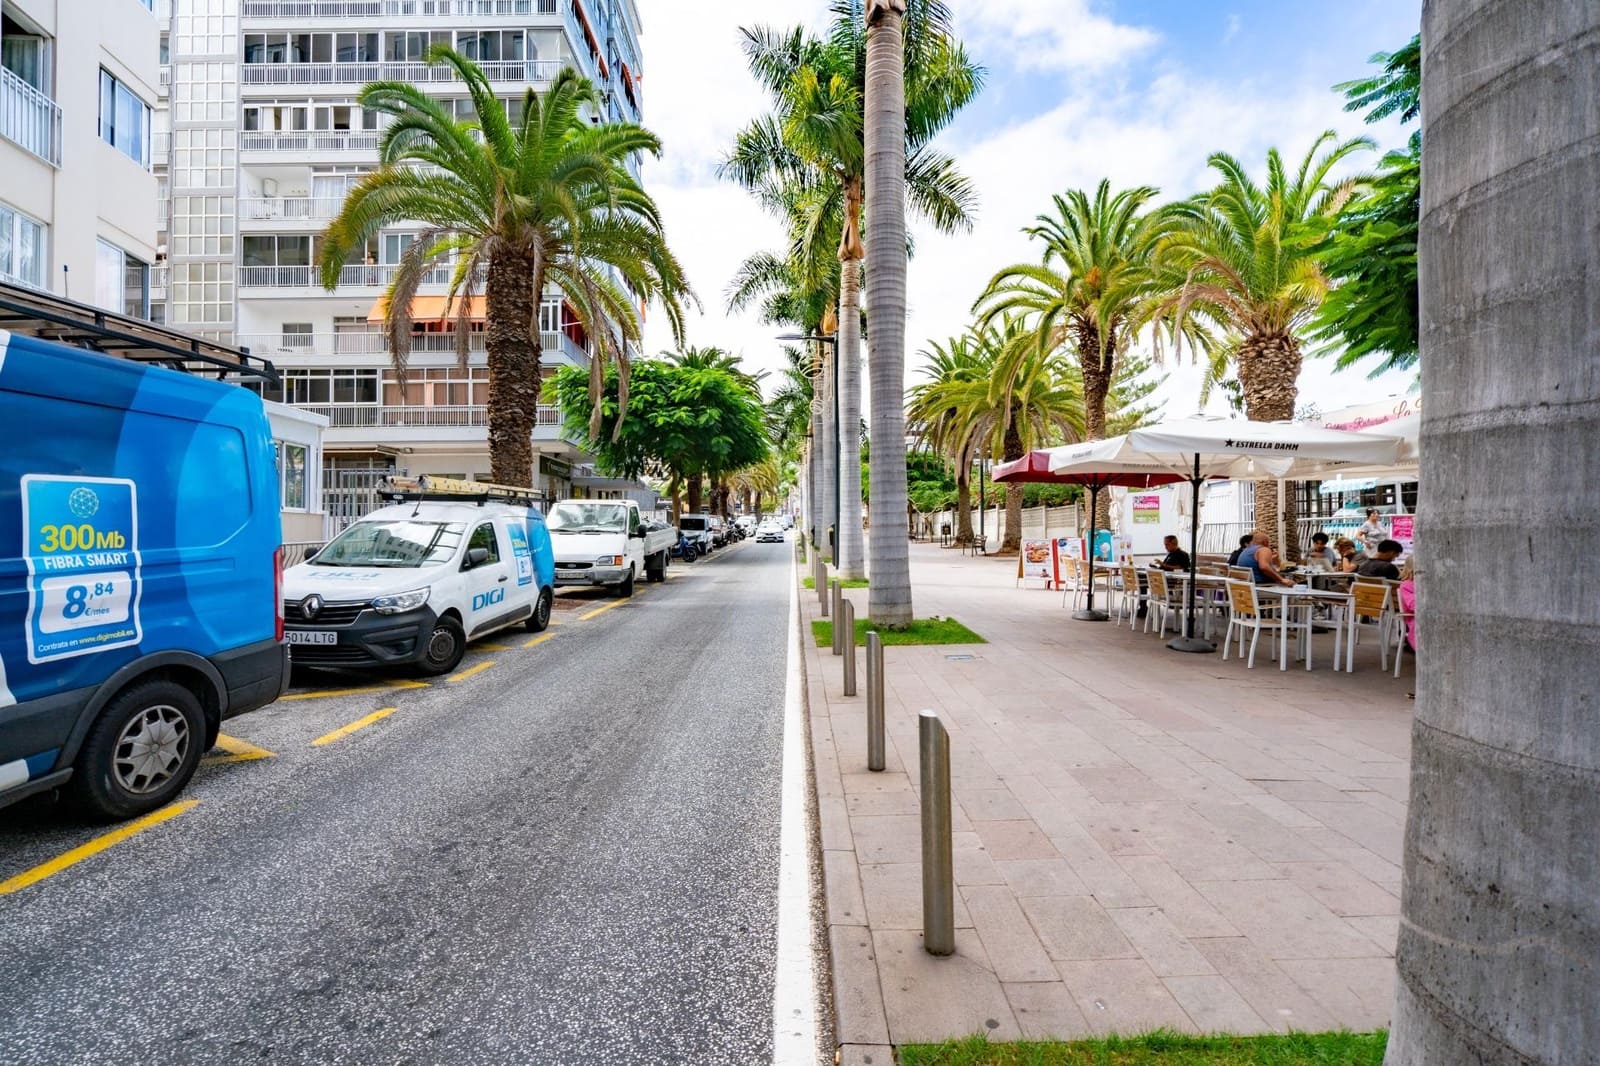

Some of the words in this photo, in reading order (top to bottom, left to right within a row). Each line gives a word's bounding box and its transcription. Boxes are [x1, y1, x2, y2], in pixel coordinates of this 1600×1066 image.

[1235, 440, 1273, 449] ESTRELLA
[1274, 442, 1300, 451] DAMM
[43, 555, 84, 570] FIBRA
[87, 552, 128, 567] SMART
[472, 587, 505, 611] DIGI
[285, 632, 311, 643] 5014
[314, 633, 335, 643] LTG
[38, 640, 69, 652] Contrata
[69, 639, 79, 647] en
